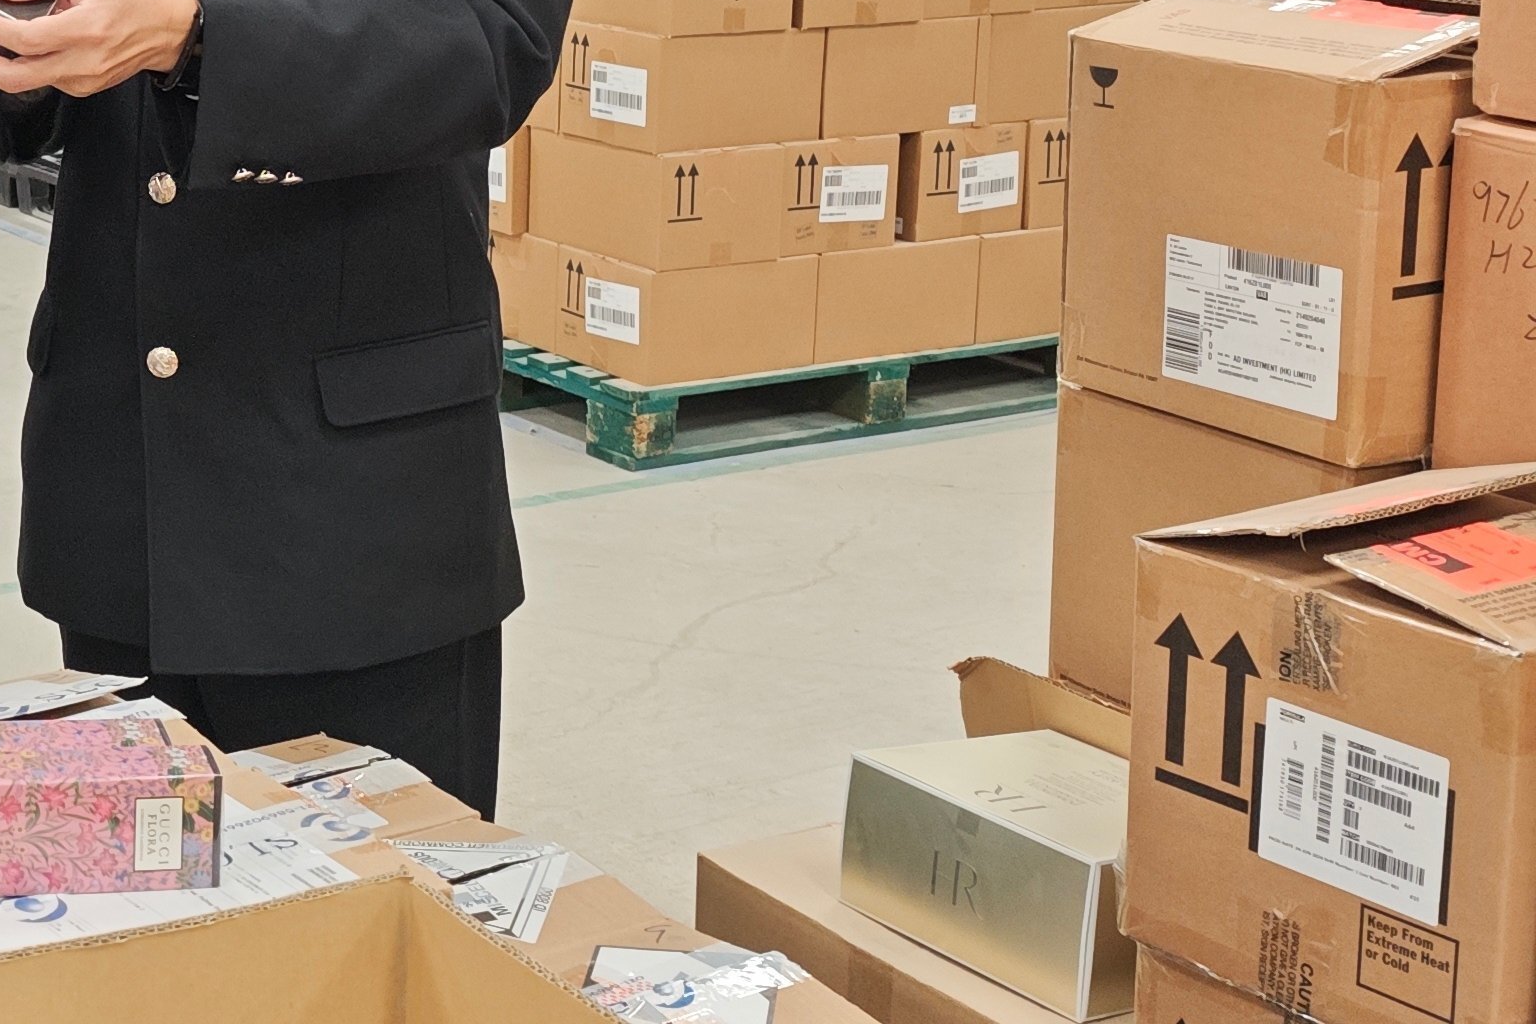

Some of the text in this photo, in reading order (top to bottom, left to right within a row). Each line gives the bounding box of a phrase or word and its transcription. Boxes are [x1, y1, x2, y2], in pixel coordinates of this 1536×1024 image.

[1293, 366, 1317, 383] LIMITED
[1278, 650, 1292, 683] ION
[147, 814, 158, 855] FLORA
[158, 803, 171, 865] GUCCI
[1281, 928, 1290, 948] NOT
[1367, 914, 1434, 951] Keep From
[1279, 949, 1288, 971] GIVE
[1287, 931, 1300, 986] BROKEN OR
[1365, 949, 1410, 974] or Cold
[1366, 931, 1450, 974] Extreme Heat
